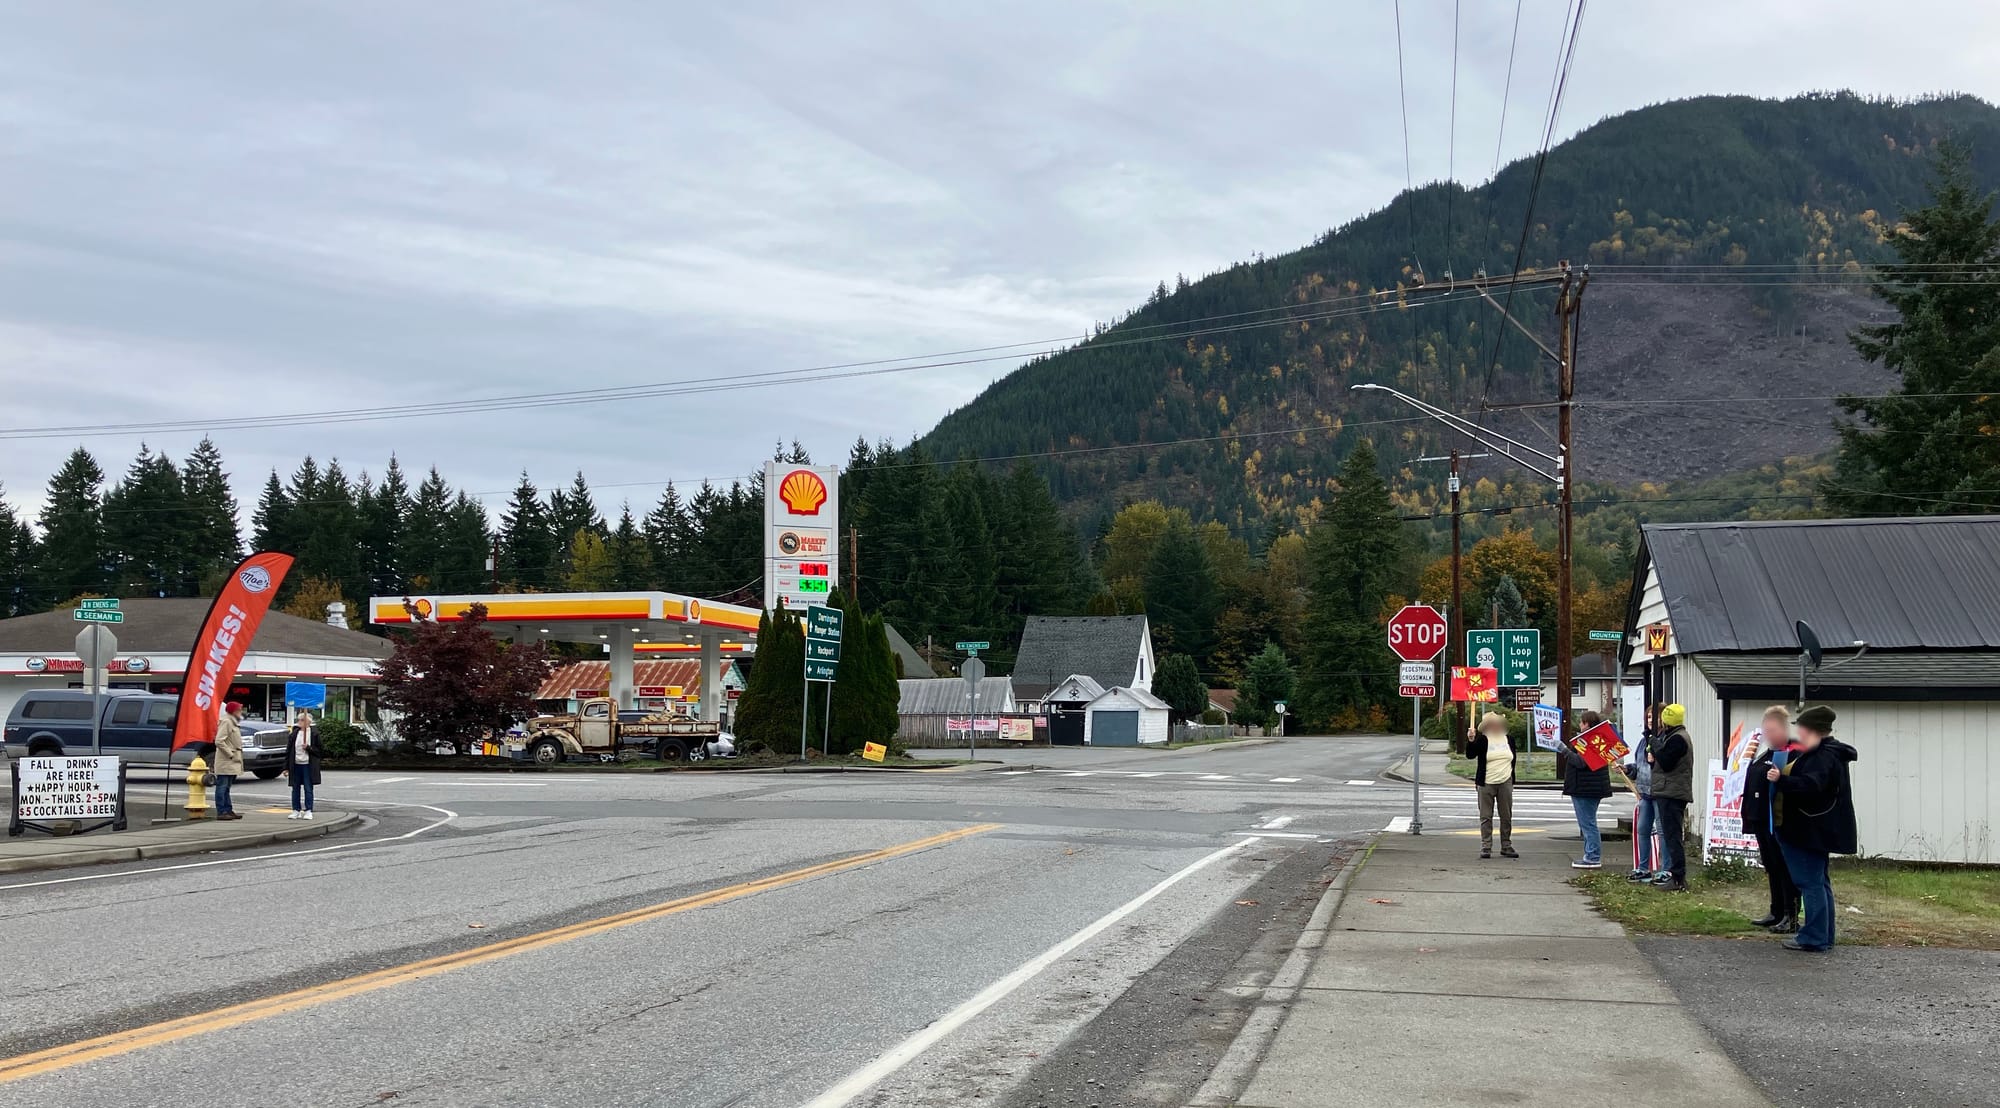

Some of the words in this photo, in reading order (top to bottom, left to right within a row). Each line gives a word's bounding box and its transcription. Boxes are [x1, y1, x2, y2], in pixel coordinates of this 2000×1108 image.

[240, 571, 270, 589] Moe's
[84, 612, 113, 620] SEEMAN
[1390, 623, 1445, 644] STOP
[1512, 634, 1530, 644] Mtn
[1476, 635, 1495, 644] EAST
[1510, 646, 1532, 657] Loop
[195, 604, 247, 711] SHAKES!
[1477, 654, 1494, 662] 530
[1511, 659, 1531, 670] Hwy
[1452, 668, 1466, 679] NO
[1467, 688, 1497, 701] KINGS
[1544, 710, 1559, 720] KINGS
[30, 760, 54, 770] FALL
[66, 759, 99, 769] DRINKS
[46, 771, 64, 781] ARE
[67, 770, 95, 780] HERE!
[35, 783, 65, 793] HAPPY
[68, 782, 92, 792] HOUR
[86, 793, 117, 803] 2-5PM
[33, 806, 84, 816] COCKTAILS
